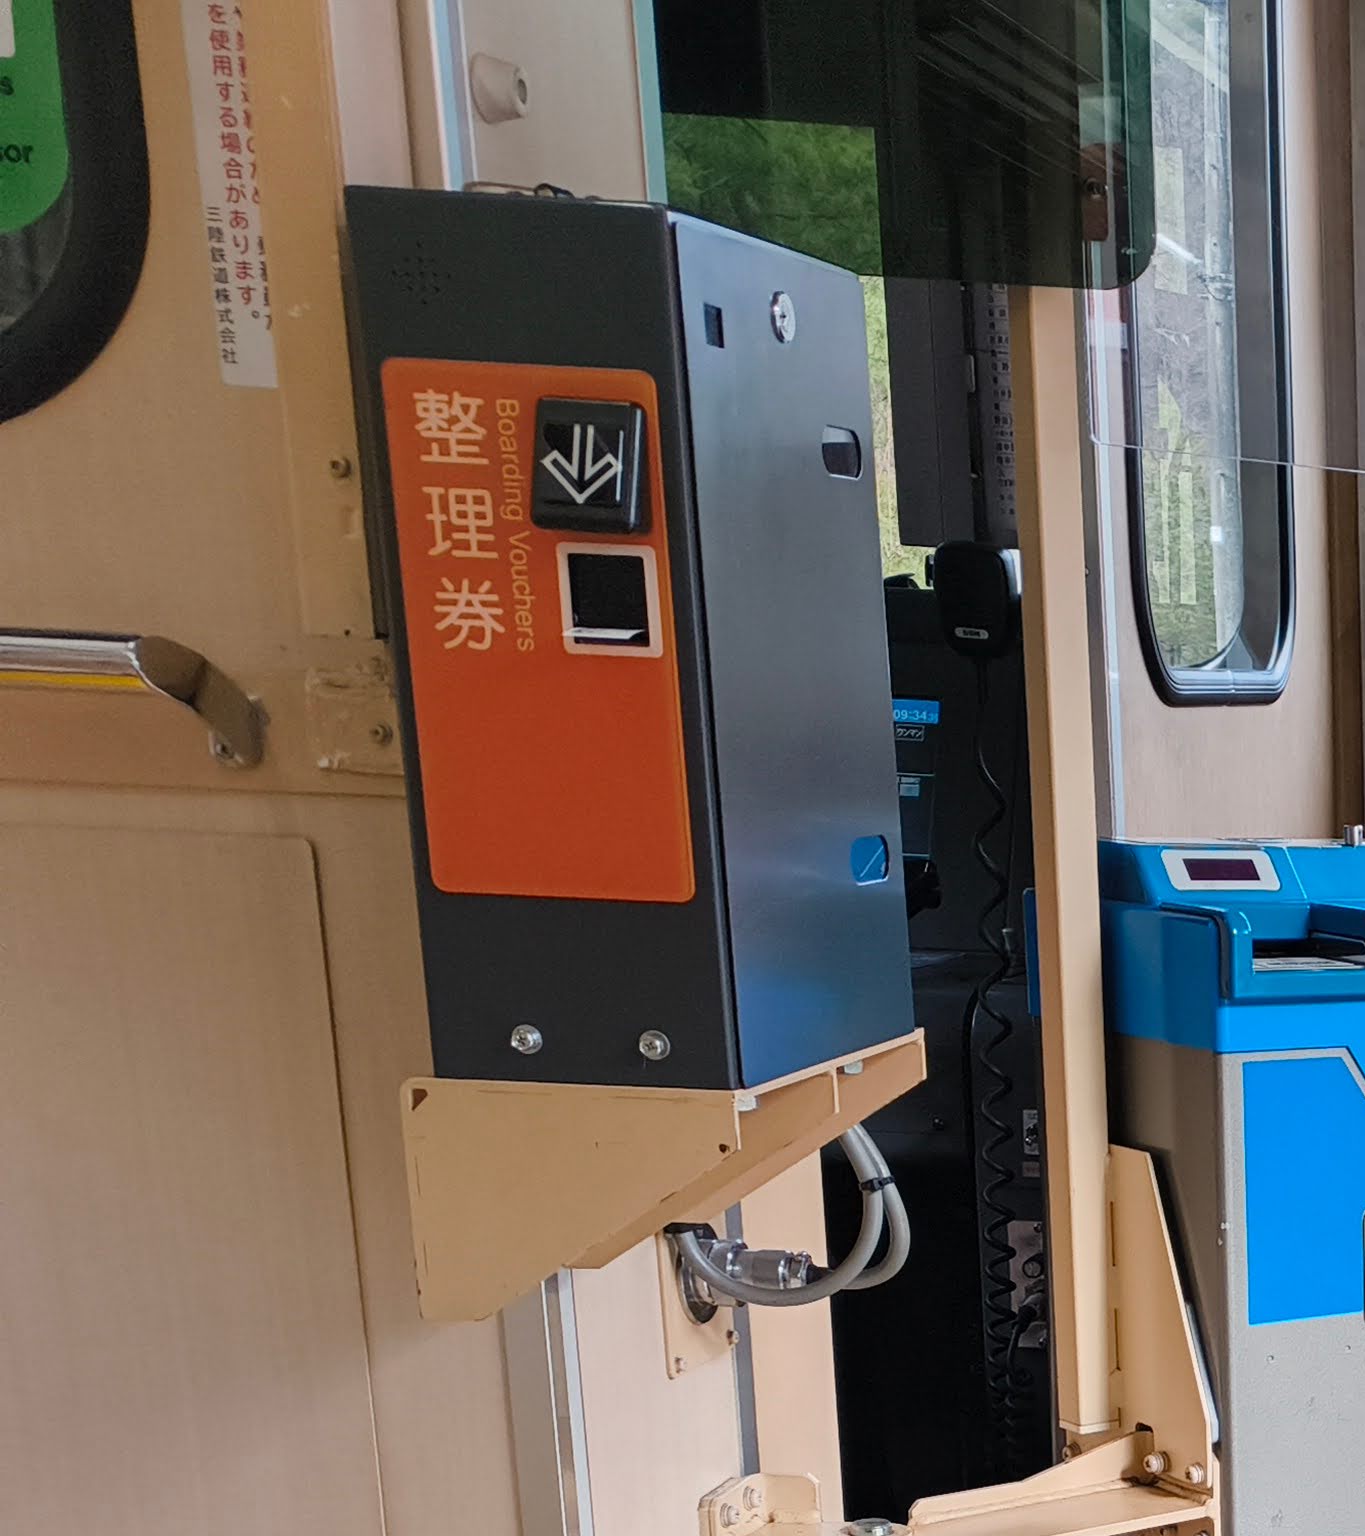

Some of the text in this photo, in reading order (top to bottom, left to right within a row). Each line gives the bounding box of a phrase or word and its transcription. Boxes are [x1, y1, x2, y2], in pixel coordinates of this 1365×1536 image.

[207, 206, 239, 365] 三陸鉄道株式会社
[413, 388, 506, 651] 整理券
[496, 398, 537, 652] Boarding Vouchers
